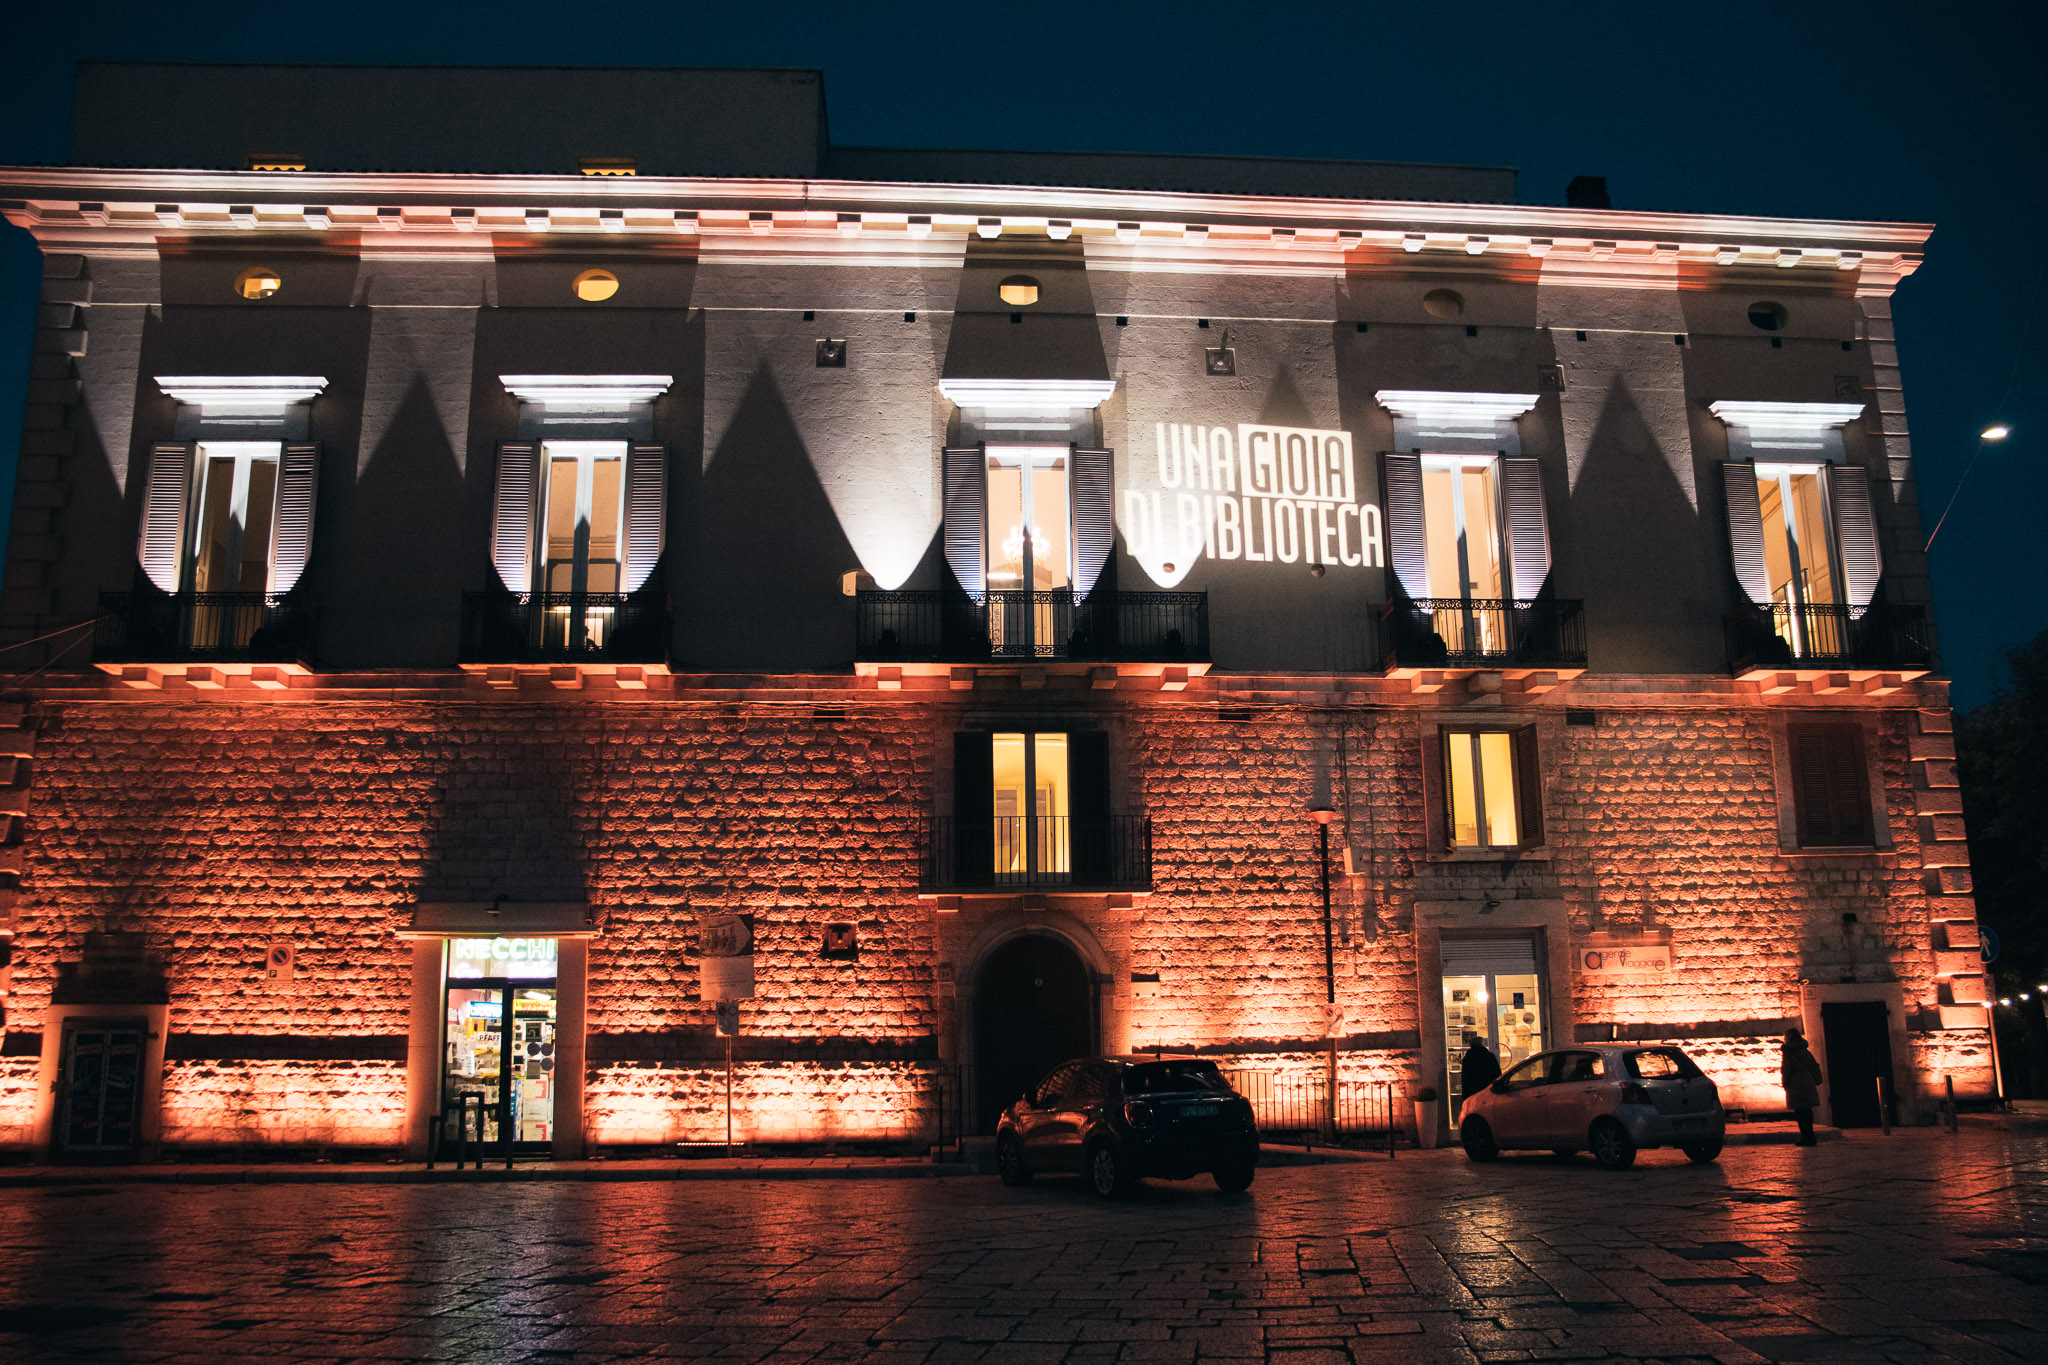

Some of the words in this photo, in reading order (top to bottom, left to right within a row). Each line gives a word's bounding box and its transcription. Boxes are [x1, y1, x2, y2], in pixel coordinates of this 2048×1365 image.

[1157, 423, 1236, 492] UNA
[1248, 431, 1348, 498] GIOIA
[1124, 488, 1161, 556] DI
[1177, 491, 1385, 568] BIBLIOTECA
[455, 937, 555, 960] NECCHI
[479, 1034, 501, 1042] PFAFF
